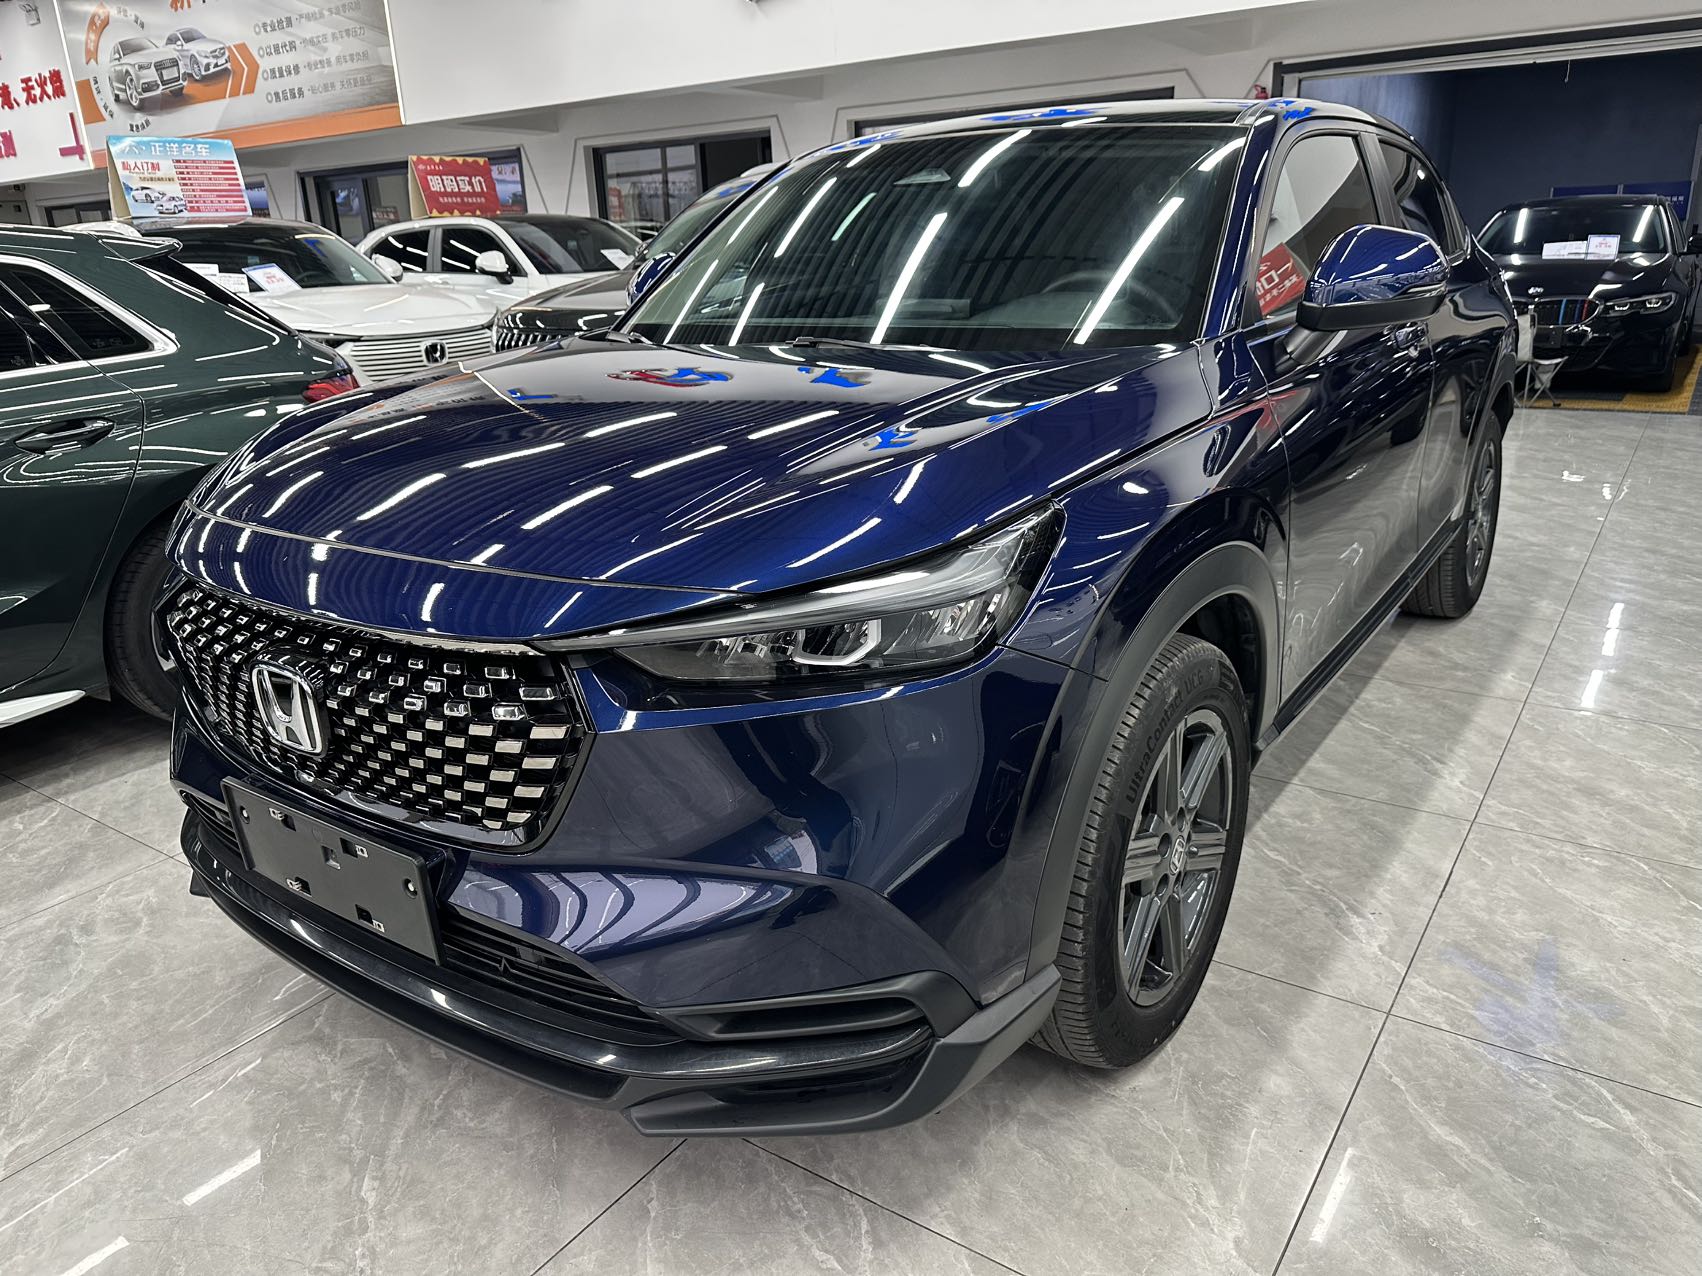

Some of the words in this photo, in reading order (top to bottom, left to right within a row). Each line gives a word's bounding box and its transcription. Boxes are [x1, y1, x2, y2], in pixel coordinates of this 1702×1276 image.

[261, 16, 293, 33] 专业检测
[265, 40, 297, 57] 以租代购
[269, 63, 301, 80] 质量保修
[274, 87, 305, 103] 售后服务
[151, 142, 211, 157] 正洋名车
[121, 161, 160, 172] 私人订制
[427, 175, 487, 193] 明码实价
[1126, 689, 1184, 804] UltraContact
